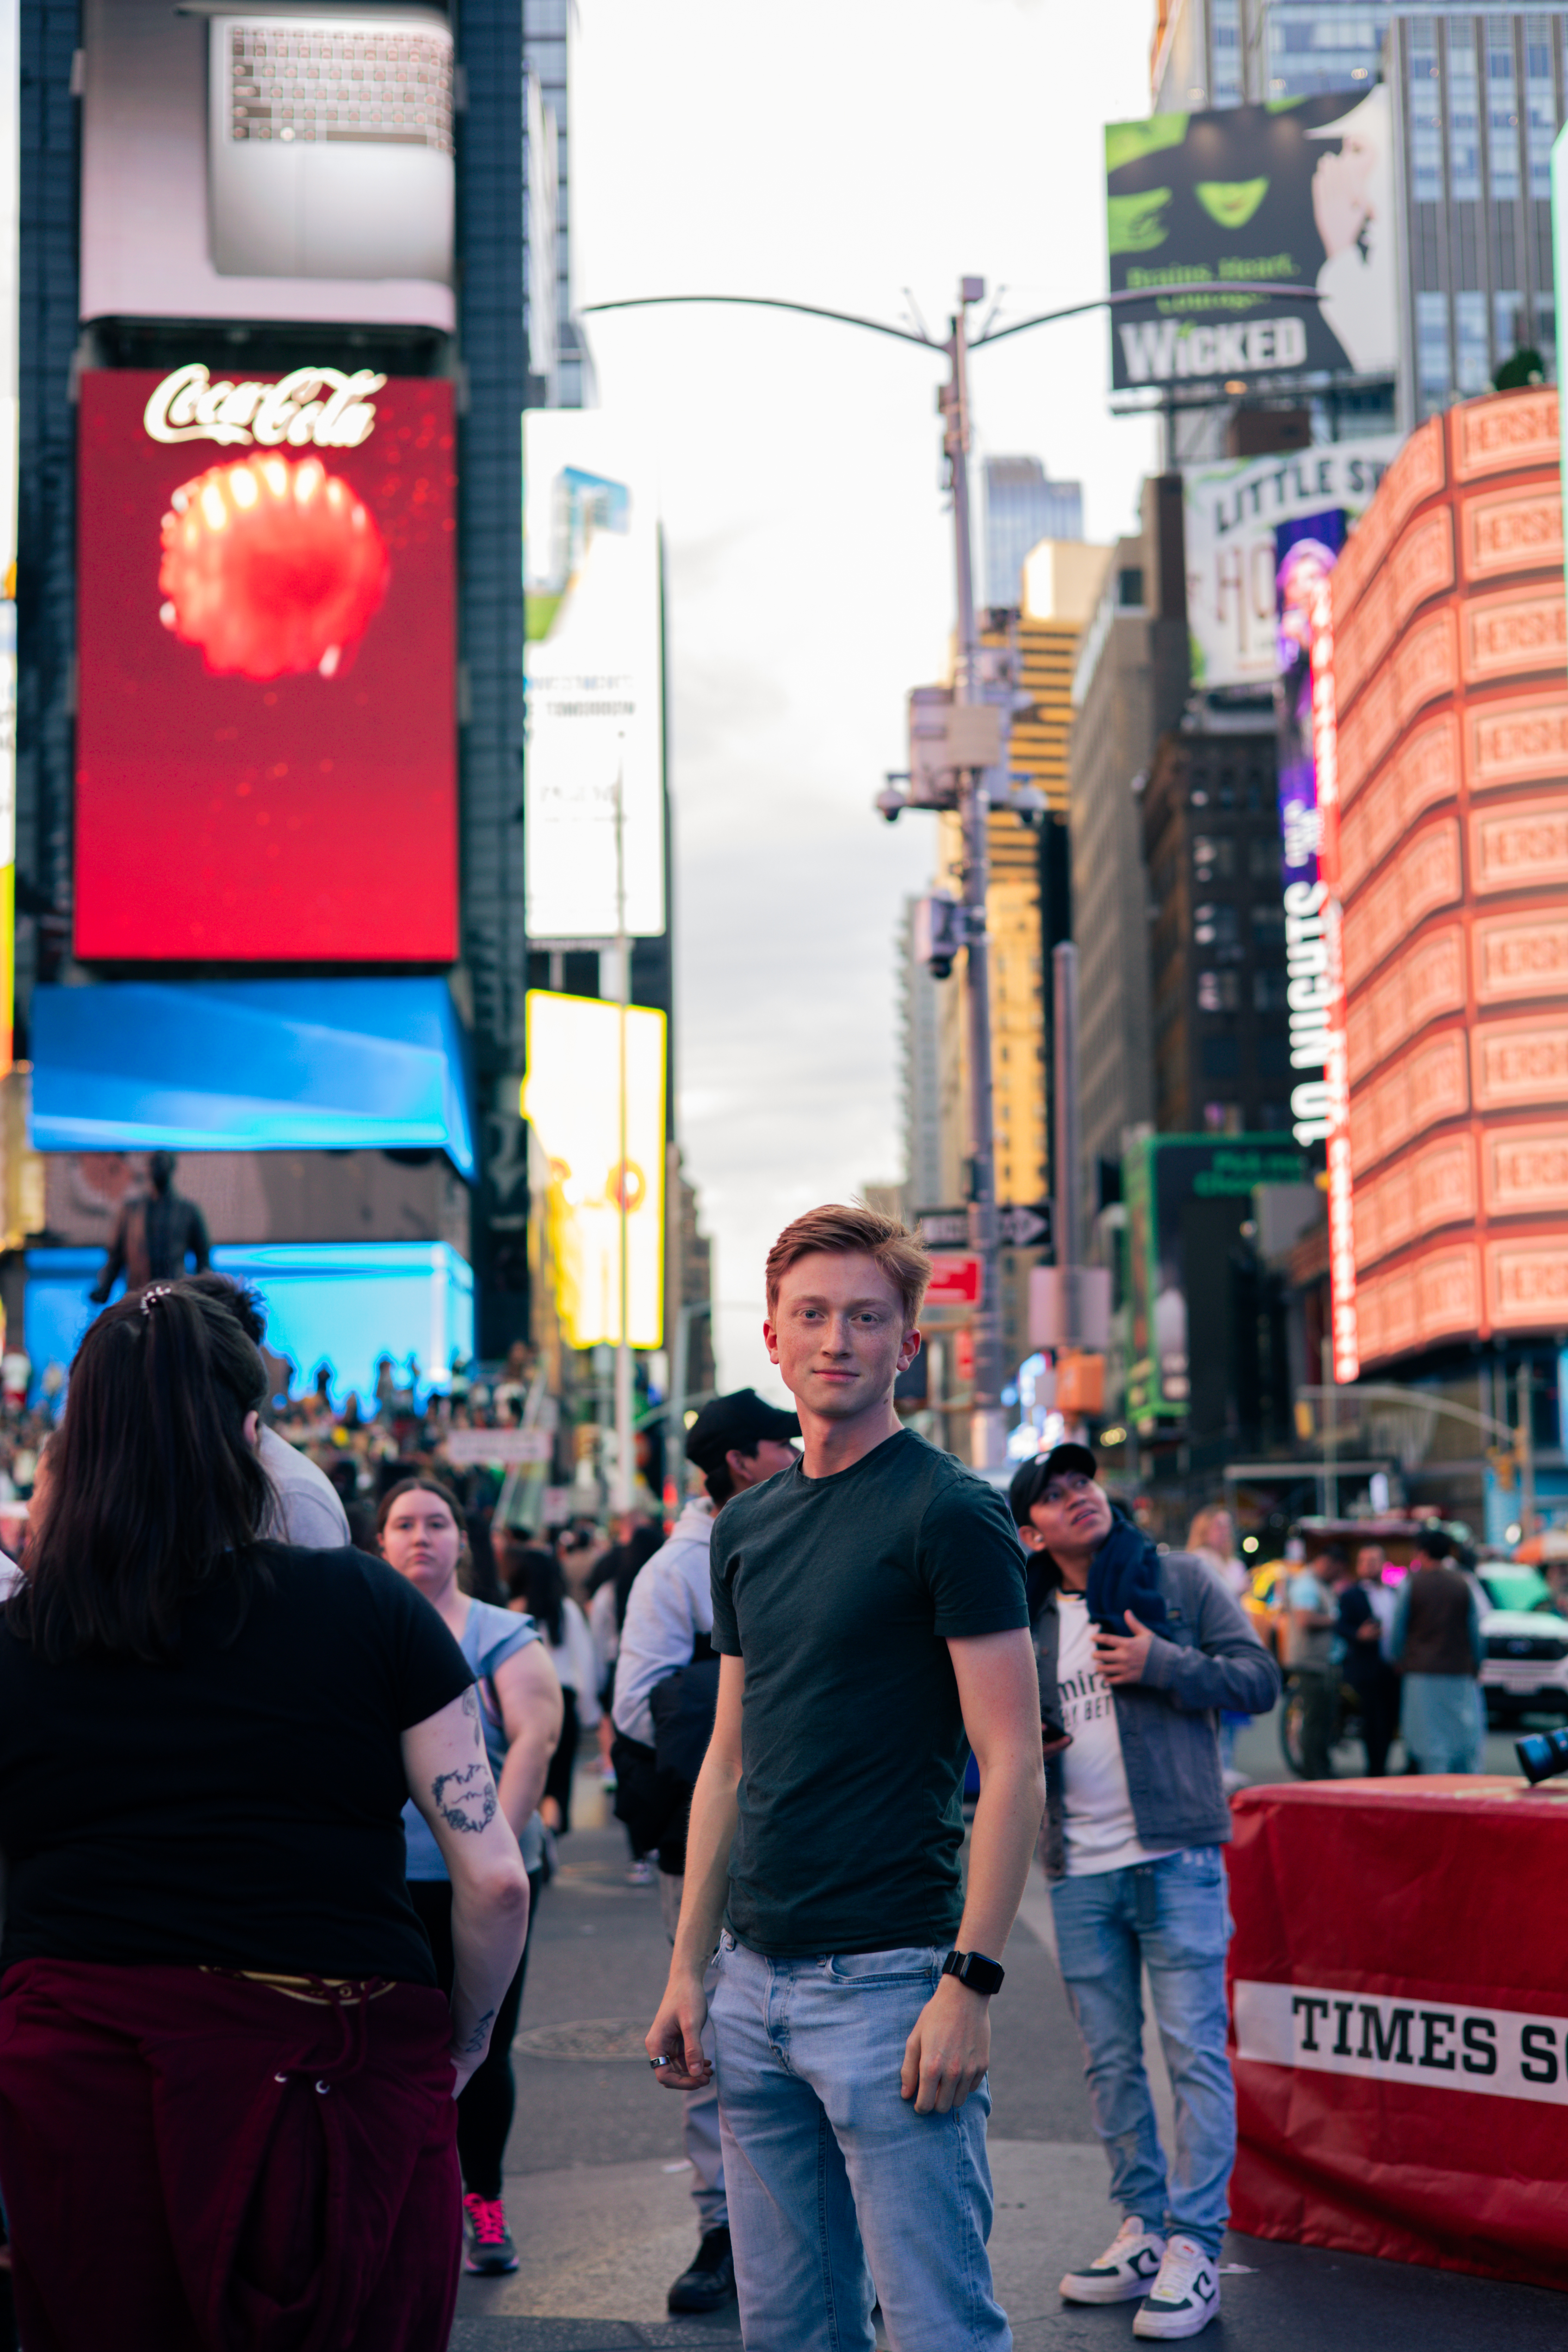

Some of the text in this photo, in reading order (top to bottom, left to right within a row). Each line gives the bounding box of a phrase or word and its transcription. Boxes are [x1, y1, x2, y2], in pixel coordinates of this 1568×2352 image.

[1216, 459, 1332, 535] LITTLE
[1284, 881, 1331, 1069] NIGHTS
[1292, 1996, 1568, 2085] TIMES S
